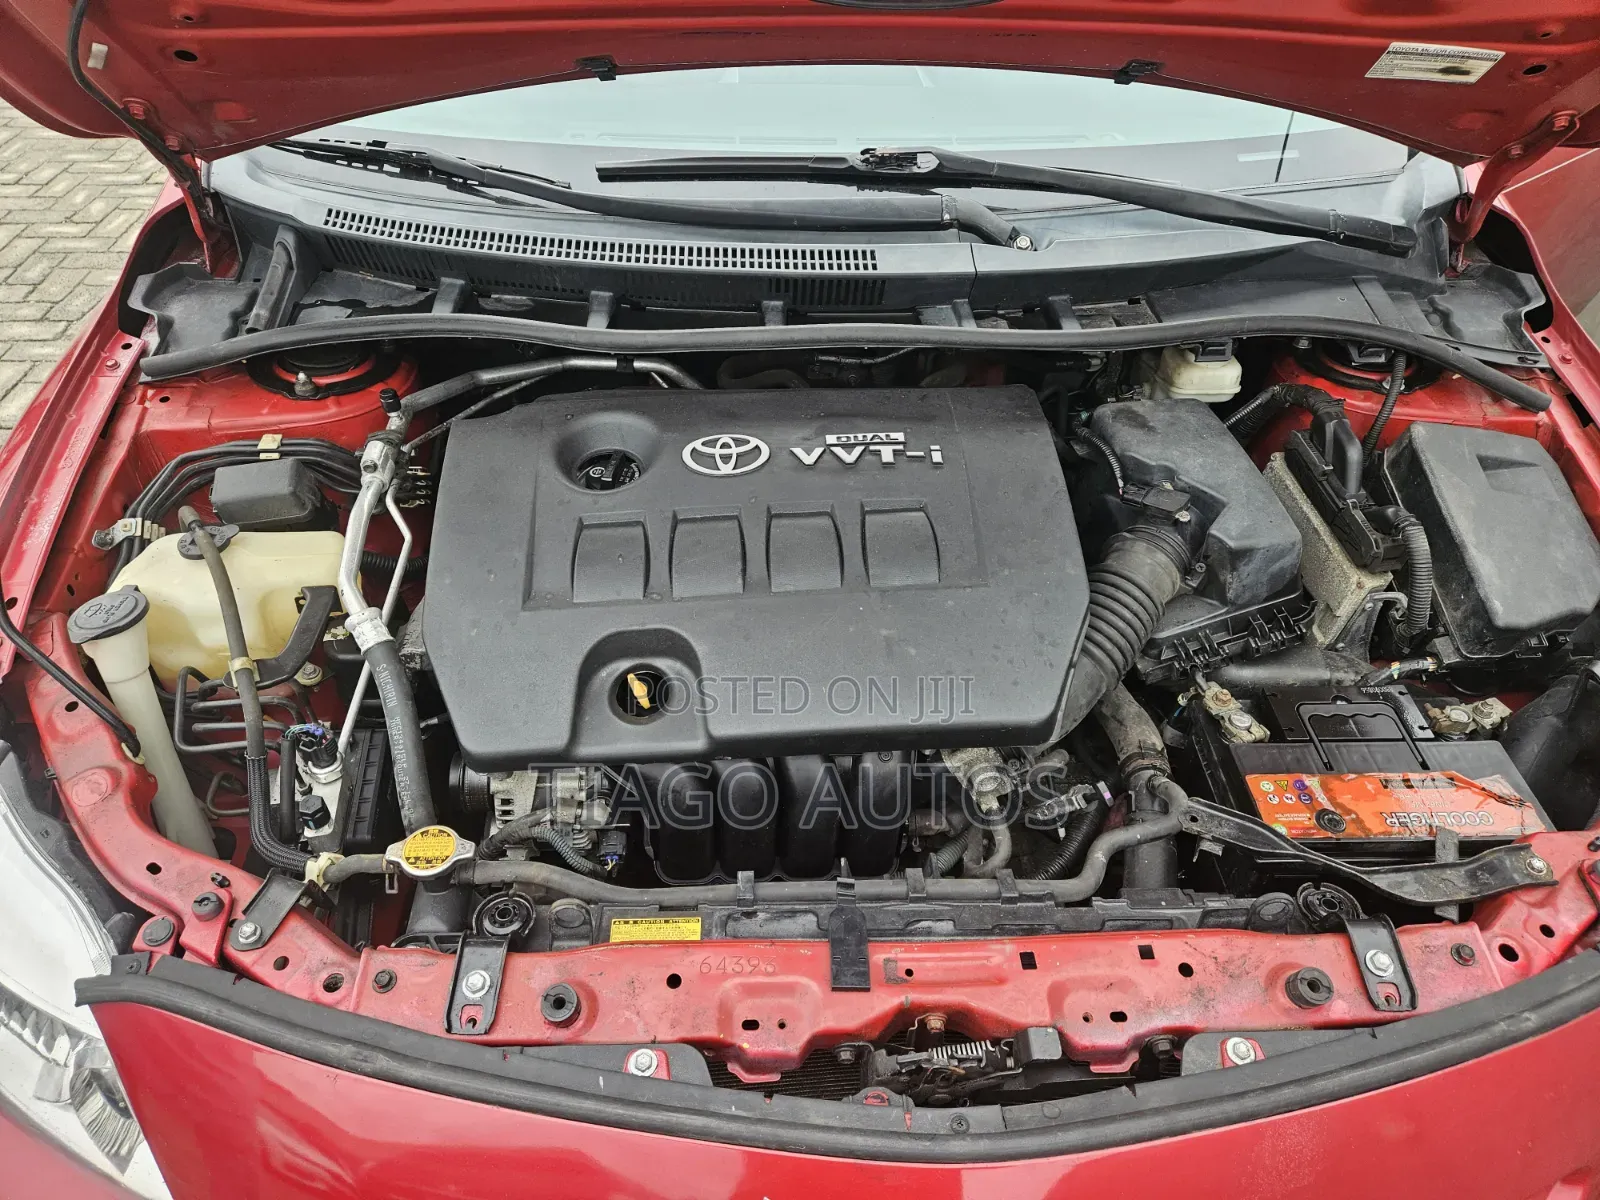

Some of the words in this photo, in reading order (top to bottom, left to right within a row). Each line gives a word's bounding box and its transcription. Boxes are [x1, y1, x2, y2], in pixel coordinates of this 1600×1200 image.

[835, 433, 900, 443] DUAL
[789, 445, 944, 467] VVT-i
[1383, 810, 1494, 827] COOLTIGER
[699, 955, 777, 975] 64393
